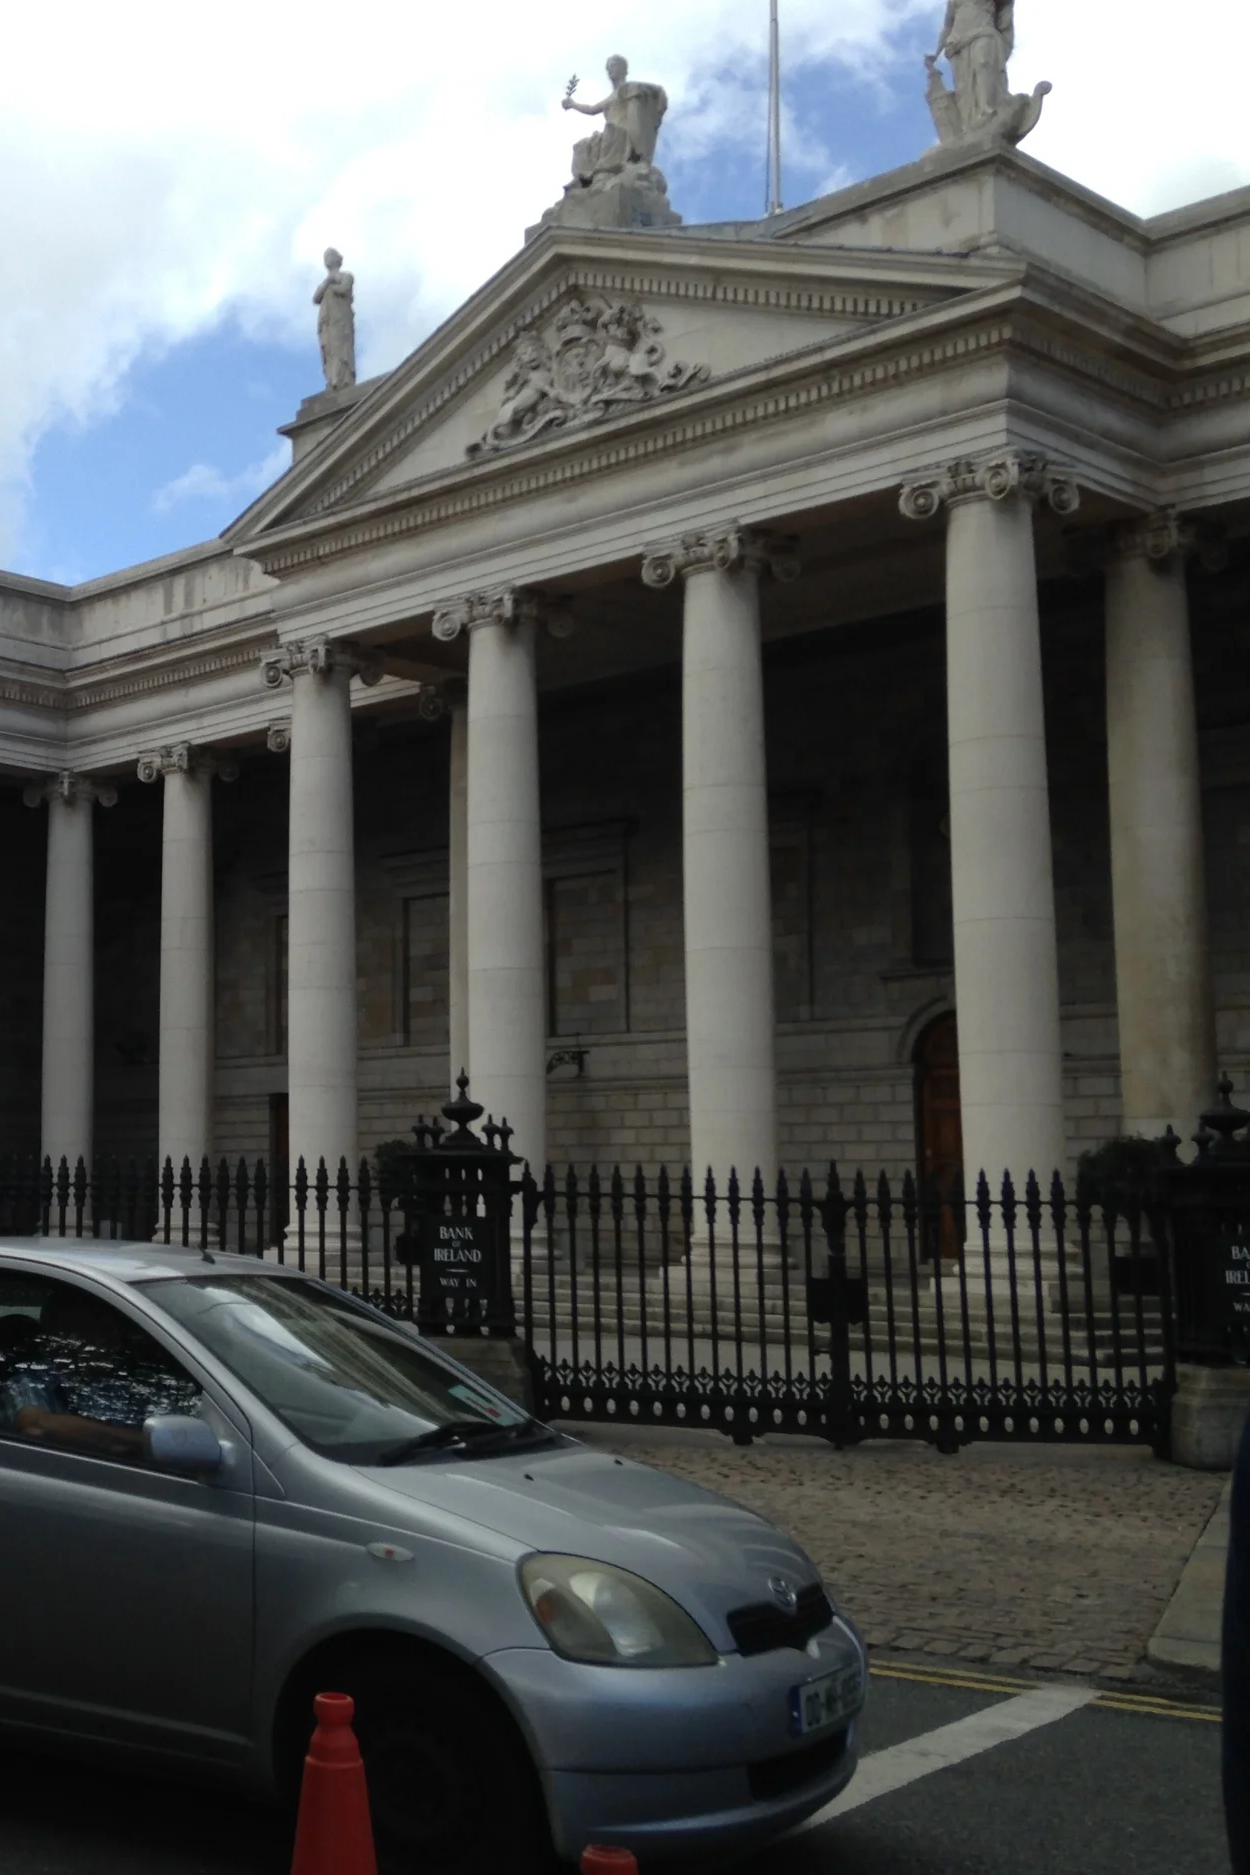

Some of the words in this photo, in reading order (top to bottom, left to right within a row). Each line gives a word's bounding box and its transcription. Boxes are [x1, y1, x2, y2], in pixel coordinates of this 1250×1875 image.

[439, 1225, 474, 1240] BANK
[433, 1247, 482, 1263] IRELAND
[1230, 1245, 1250, 1260] BA
[439, 1277, 460, 1288] WAY
[465, 1277, 477, 1288] IN
[1225, 1269, 1250, 1284] IREL
[1233, 1302, 1250, 1312] WA
